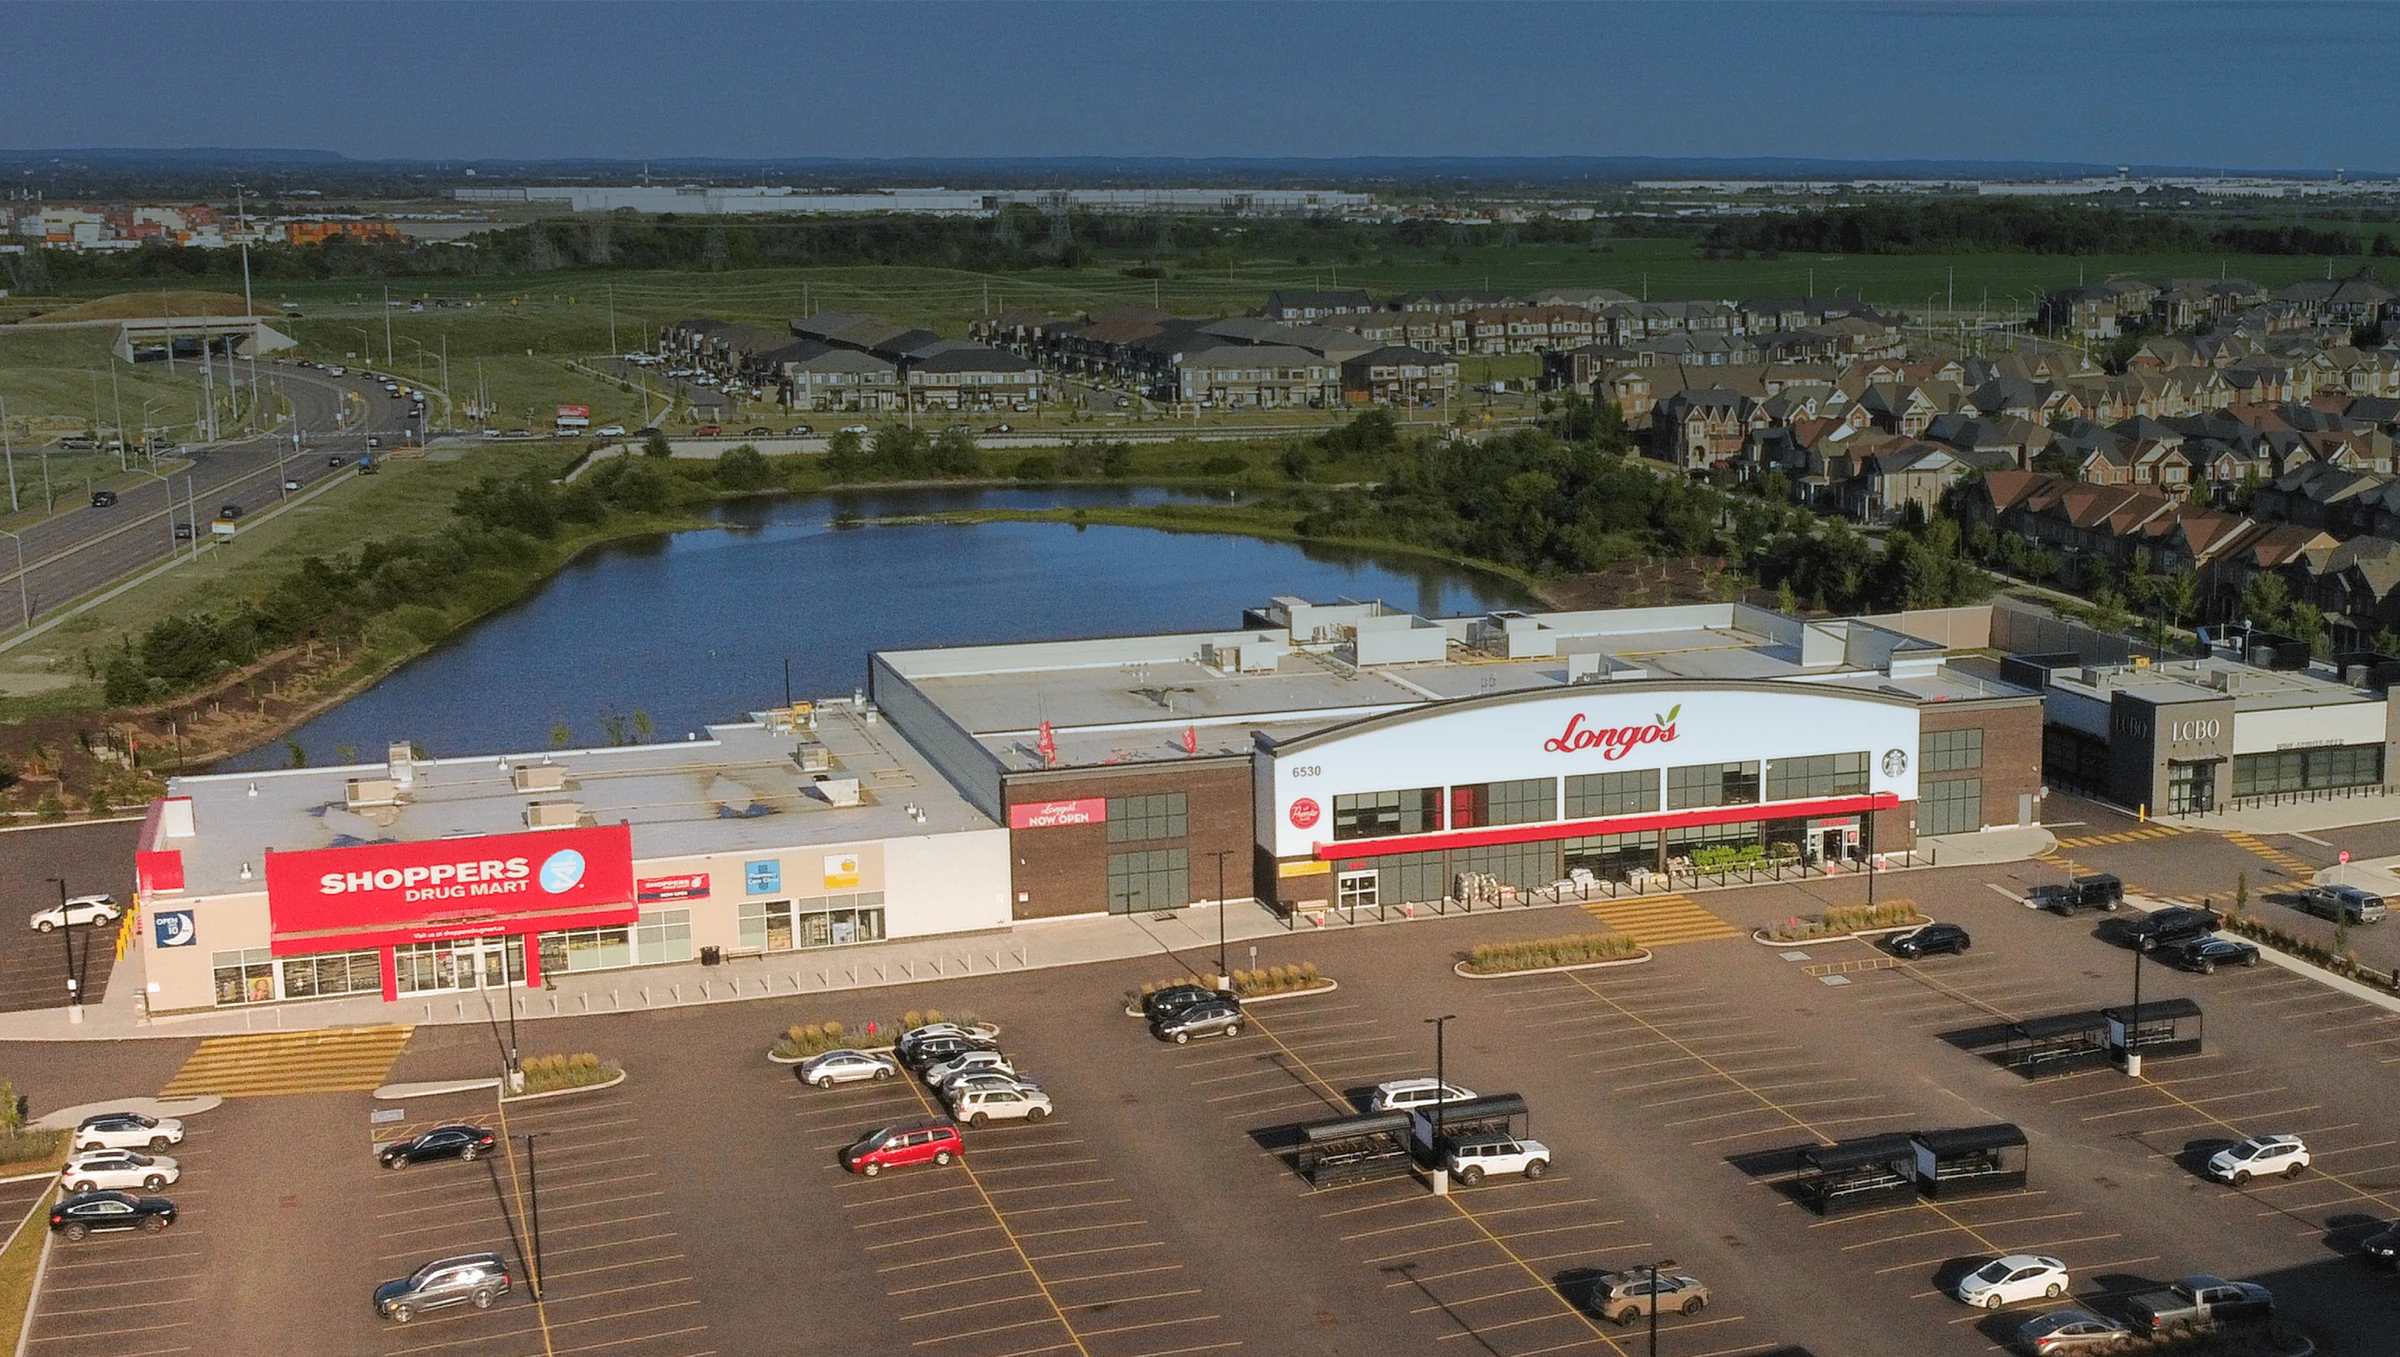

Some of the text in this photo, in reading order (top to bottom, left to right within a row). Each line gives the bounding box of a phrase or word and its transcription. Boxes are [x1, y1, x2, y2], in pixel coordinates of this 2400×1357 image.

[2172, 719, 2220, 741] LCBO
[1292, 765, 1321, 778] 6530
[1029, 813, 1089, 826] NOW OPEN
[319, 857, 531, 895] SHOPPERS
[405, 879, 530, 902] DRUG MART
[168, 926, 178, 935] 10
